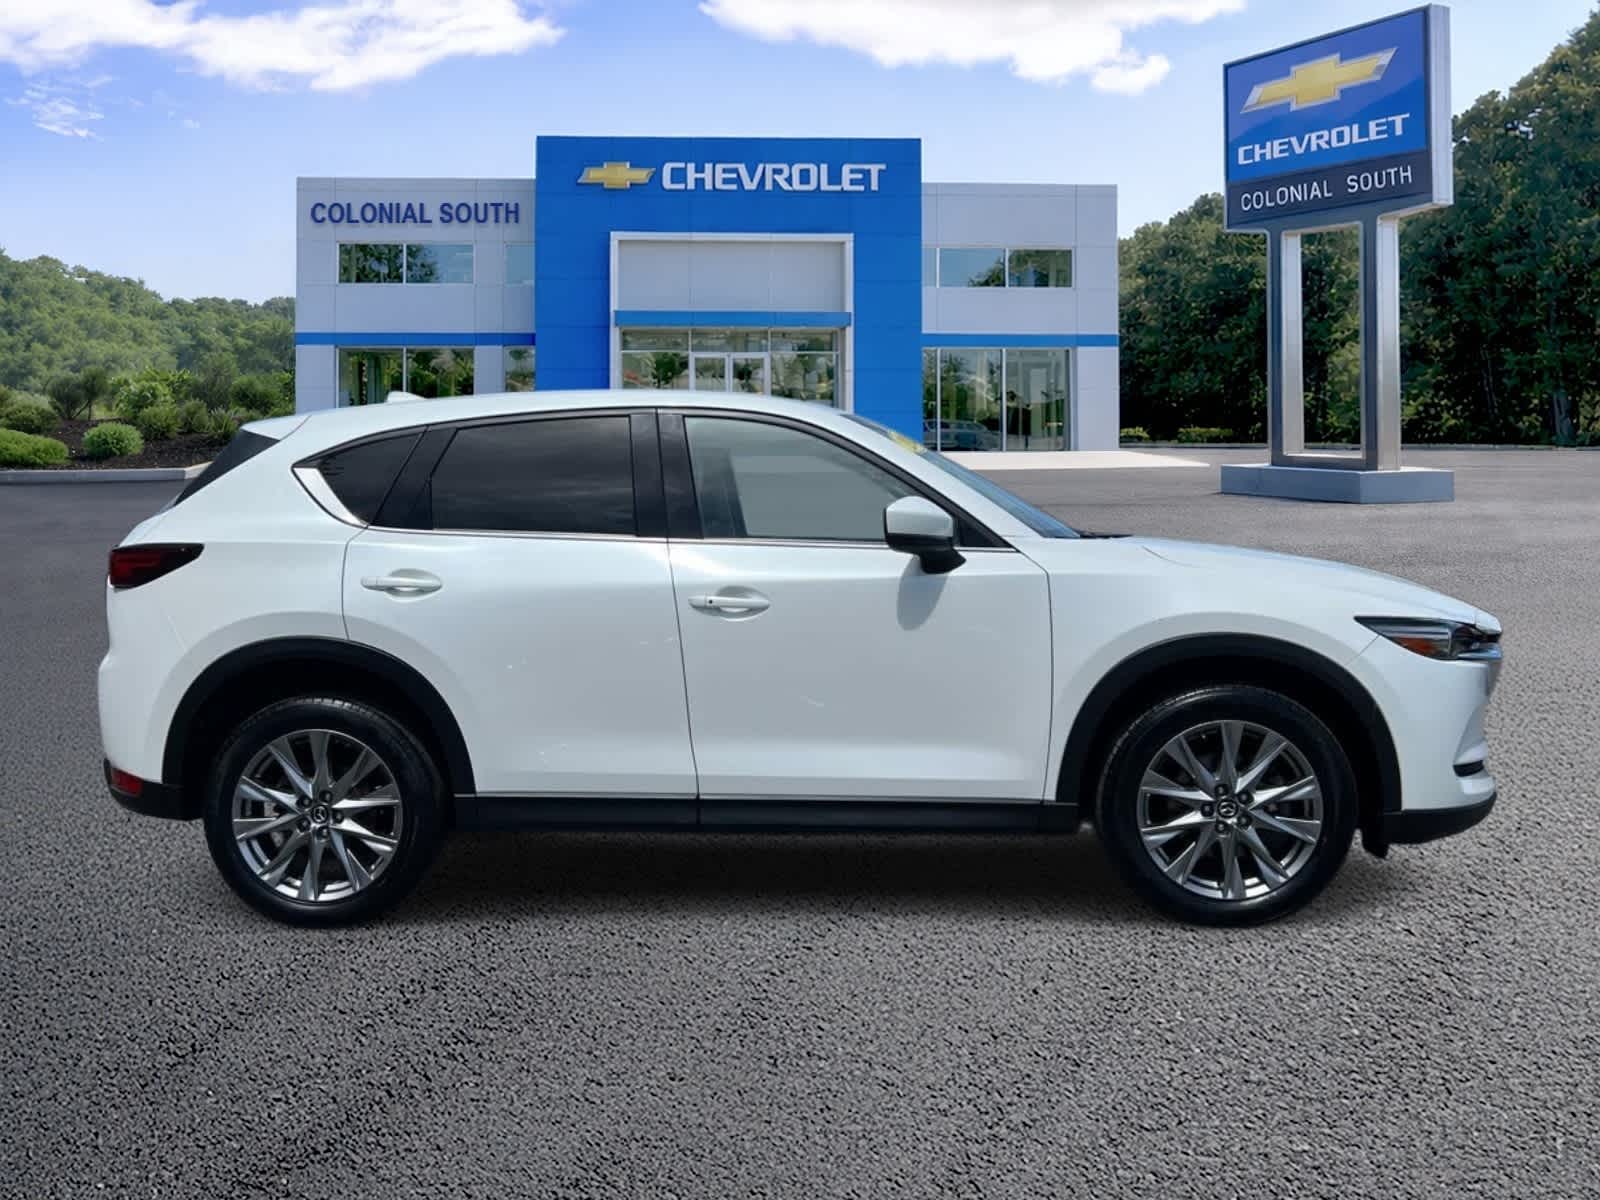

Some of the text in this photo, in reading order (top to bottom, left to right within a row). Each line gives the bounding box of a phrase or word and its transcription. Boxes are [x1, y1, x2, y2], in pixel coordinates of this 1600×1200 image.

[1238, 113, 1410, 165] CHEVROLET
[661, 162, 886, 192] CHEVROLET
[1241, 166, 1412, 211] COLONIAL SOUTH
[310, 201, 521, 225] COLONIAL SOUTH
